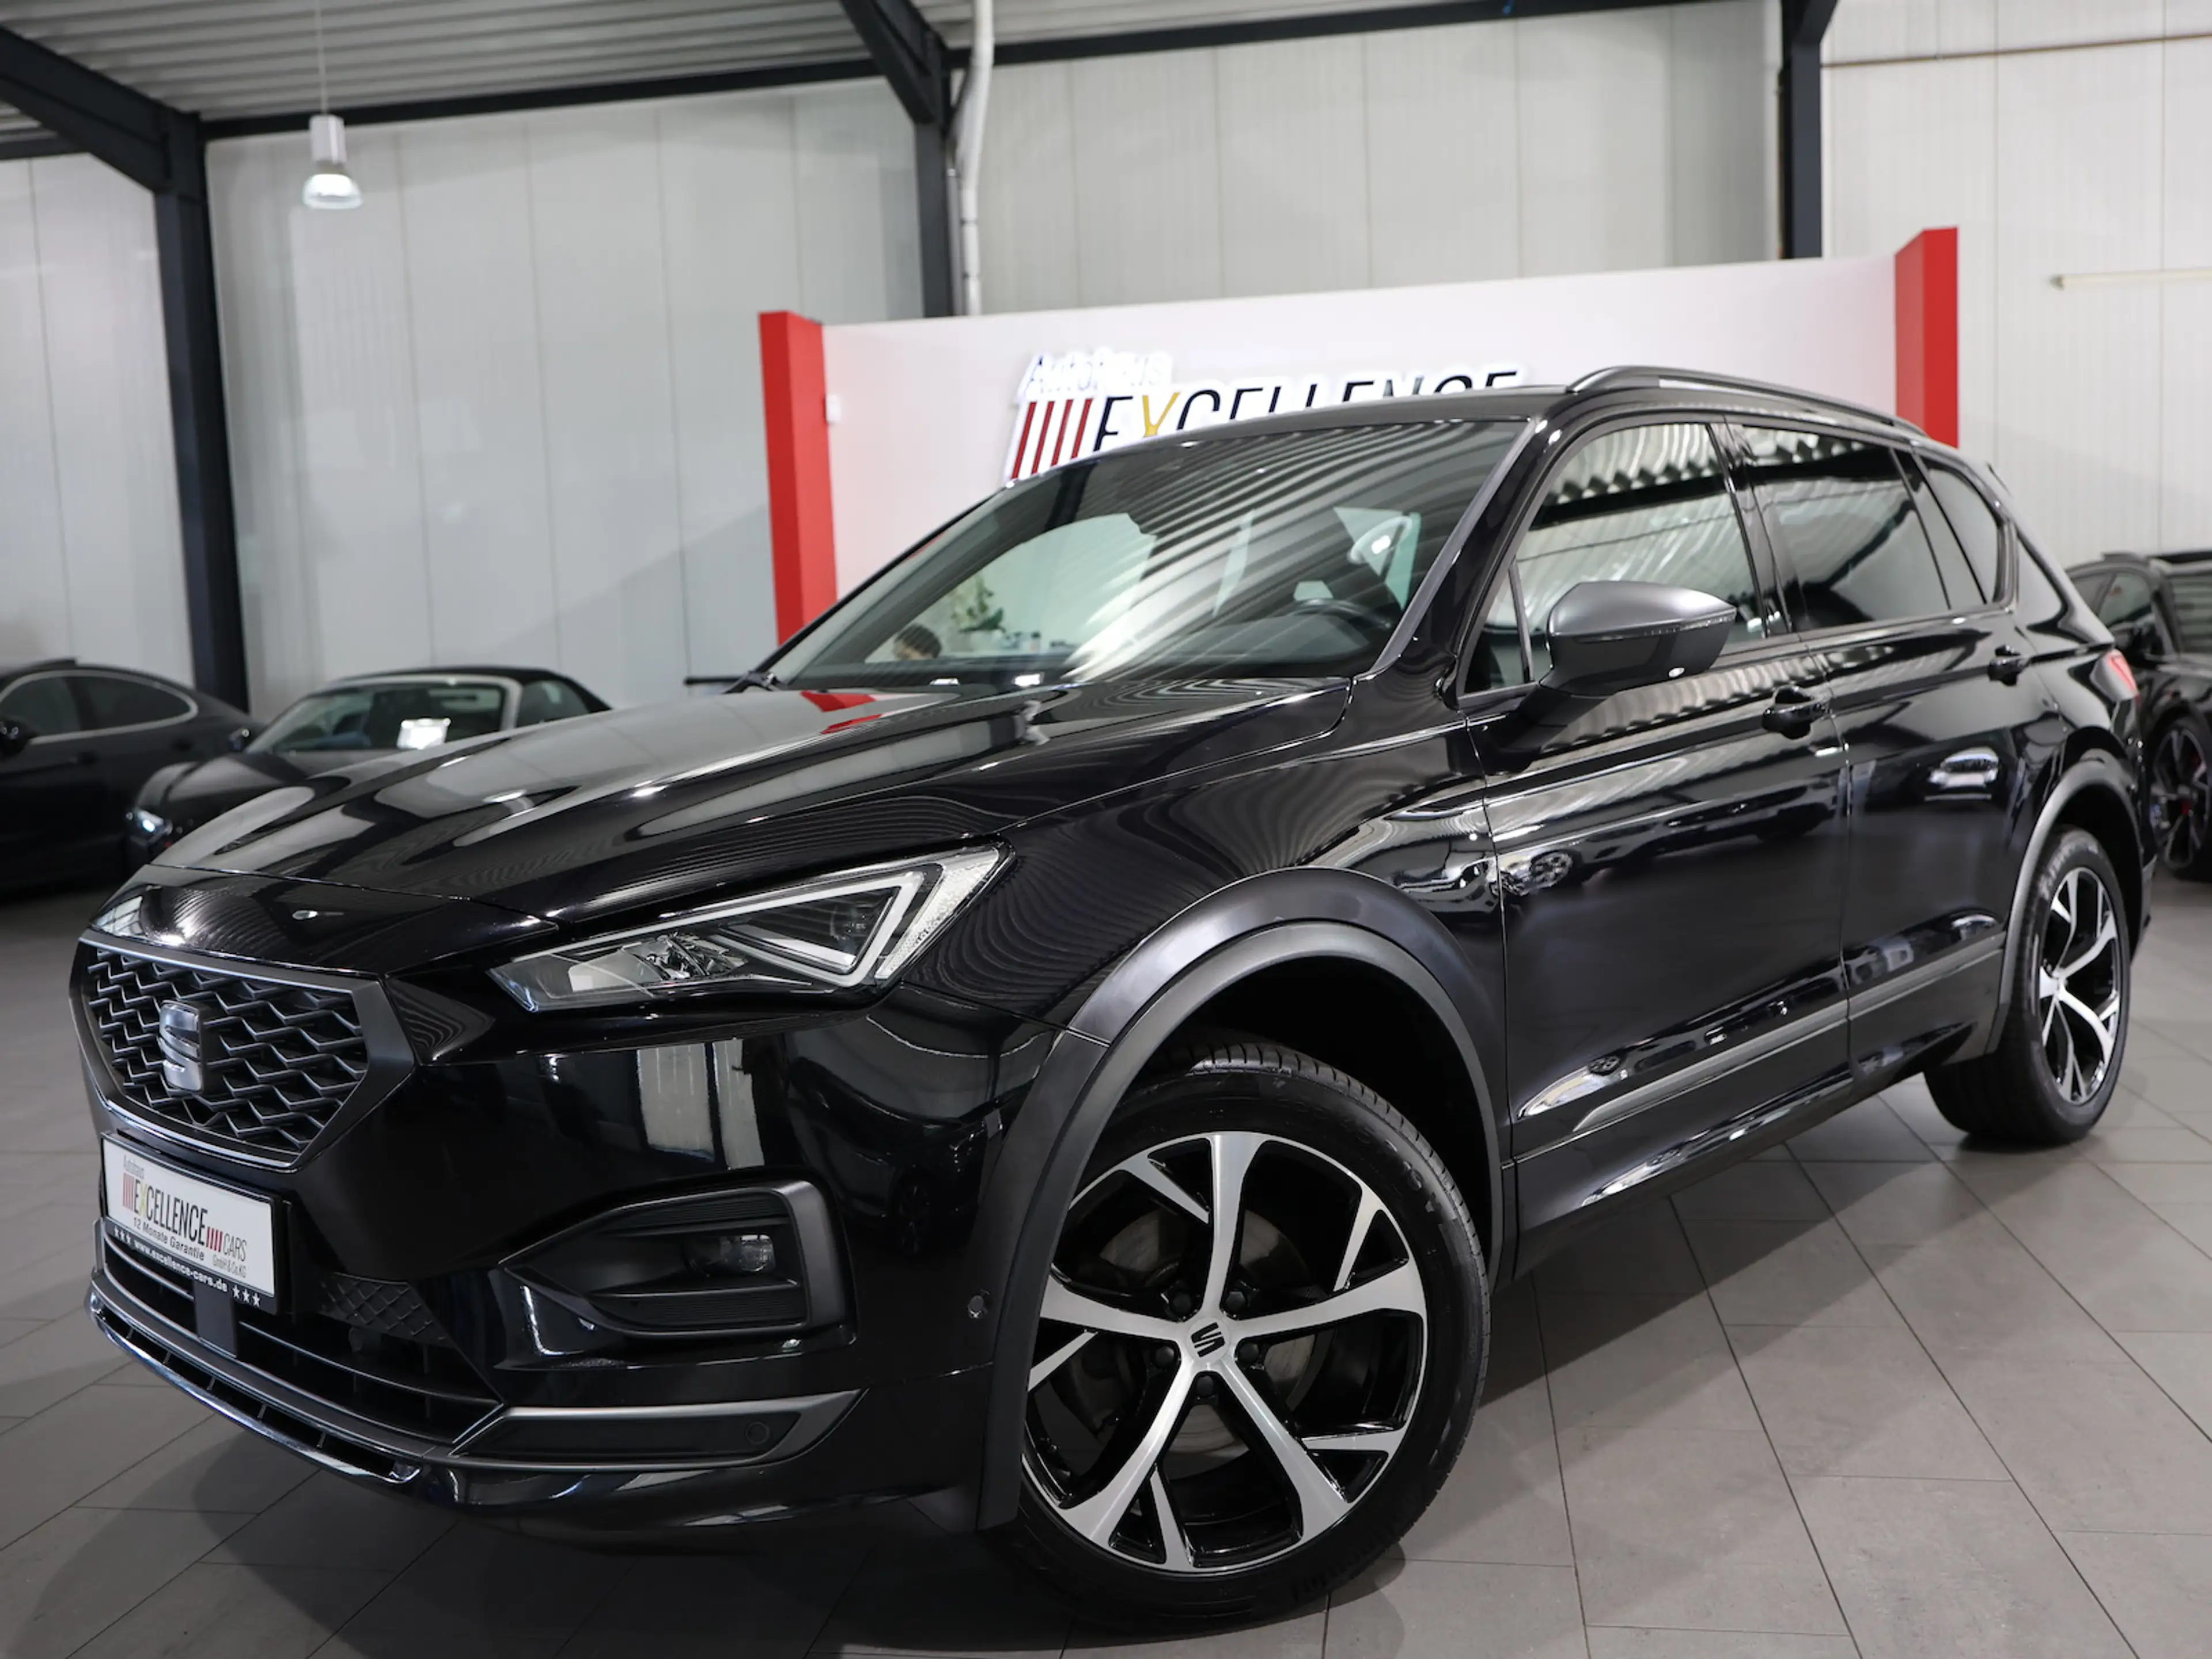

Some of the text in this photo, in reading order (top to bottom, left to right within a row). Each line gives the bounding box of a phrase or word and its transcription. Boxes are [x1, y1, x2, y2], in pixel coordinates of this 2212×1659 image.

[134, 1178, 247, 1262] EXCELLENCE CARS
[134, 1217, 205, 1261] 12 Monate Garantie
[134, 1239, 228, 1293] www.excellence-cars.de
